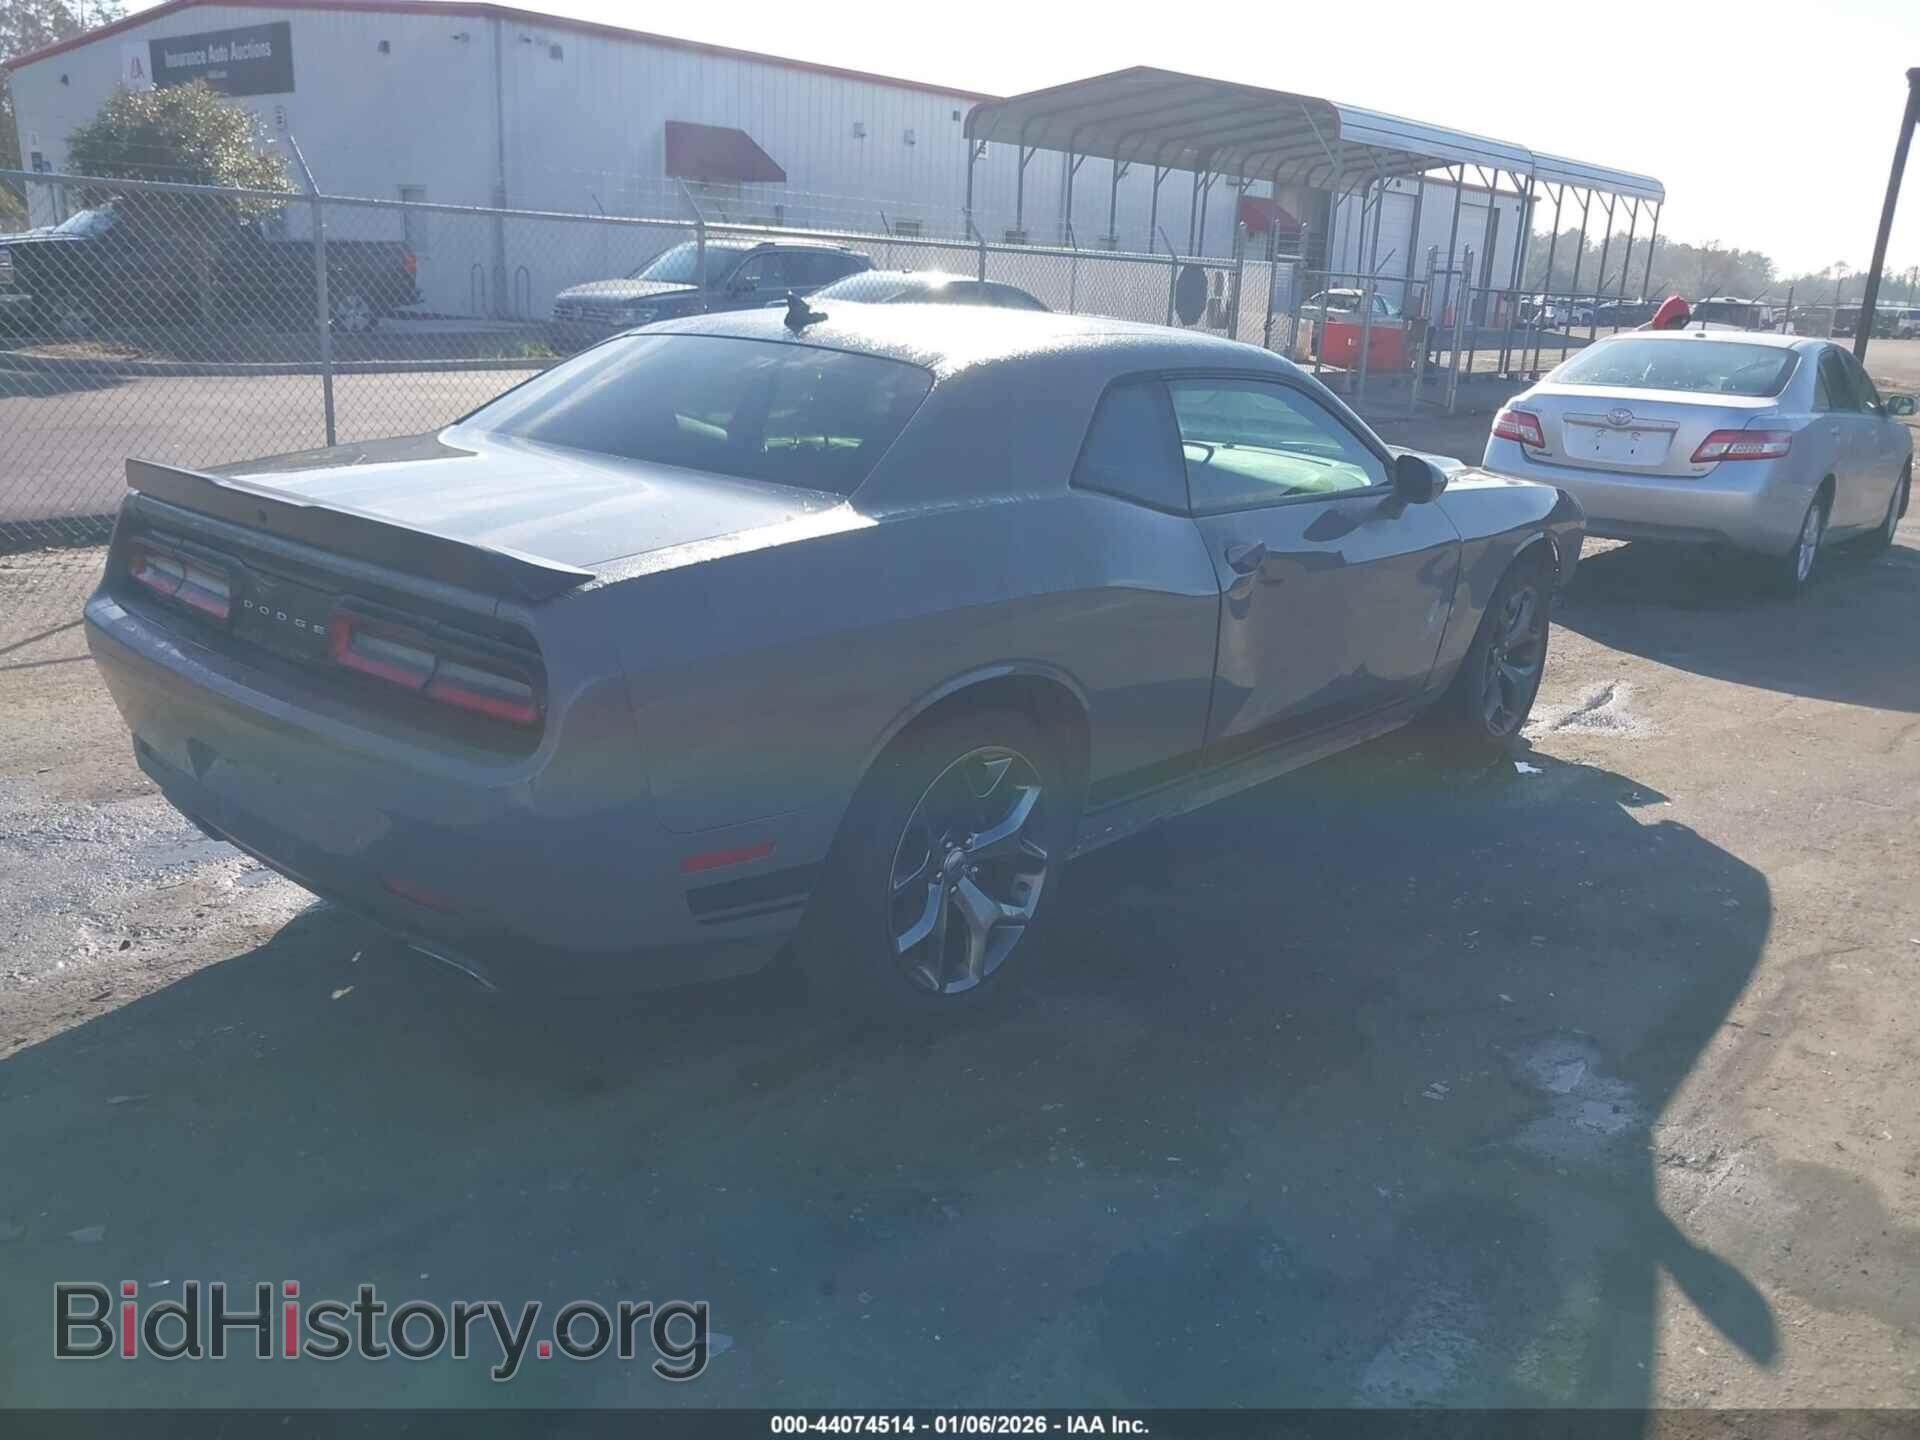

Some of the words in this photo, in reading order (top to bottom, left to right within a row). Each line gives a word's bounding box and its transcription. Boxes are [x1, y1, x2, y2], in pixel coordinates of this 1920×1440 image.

[207, 43, 229, 63] Auto
[230, 38, 273, 61] Auctions
[243, 599, 326, 635] DODGE
